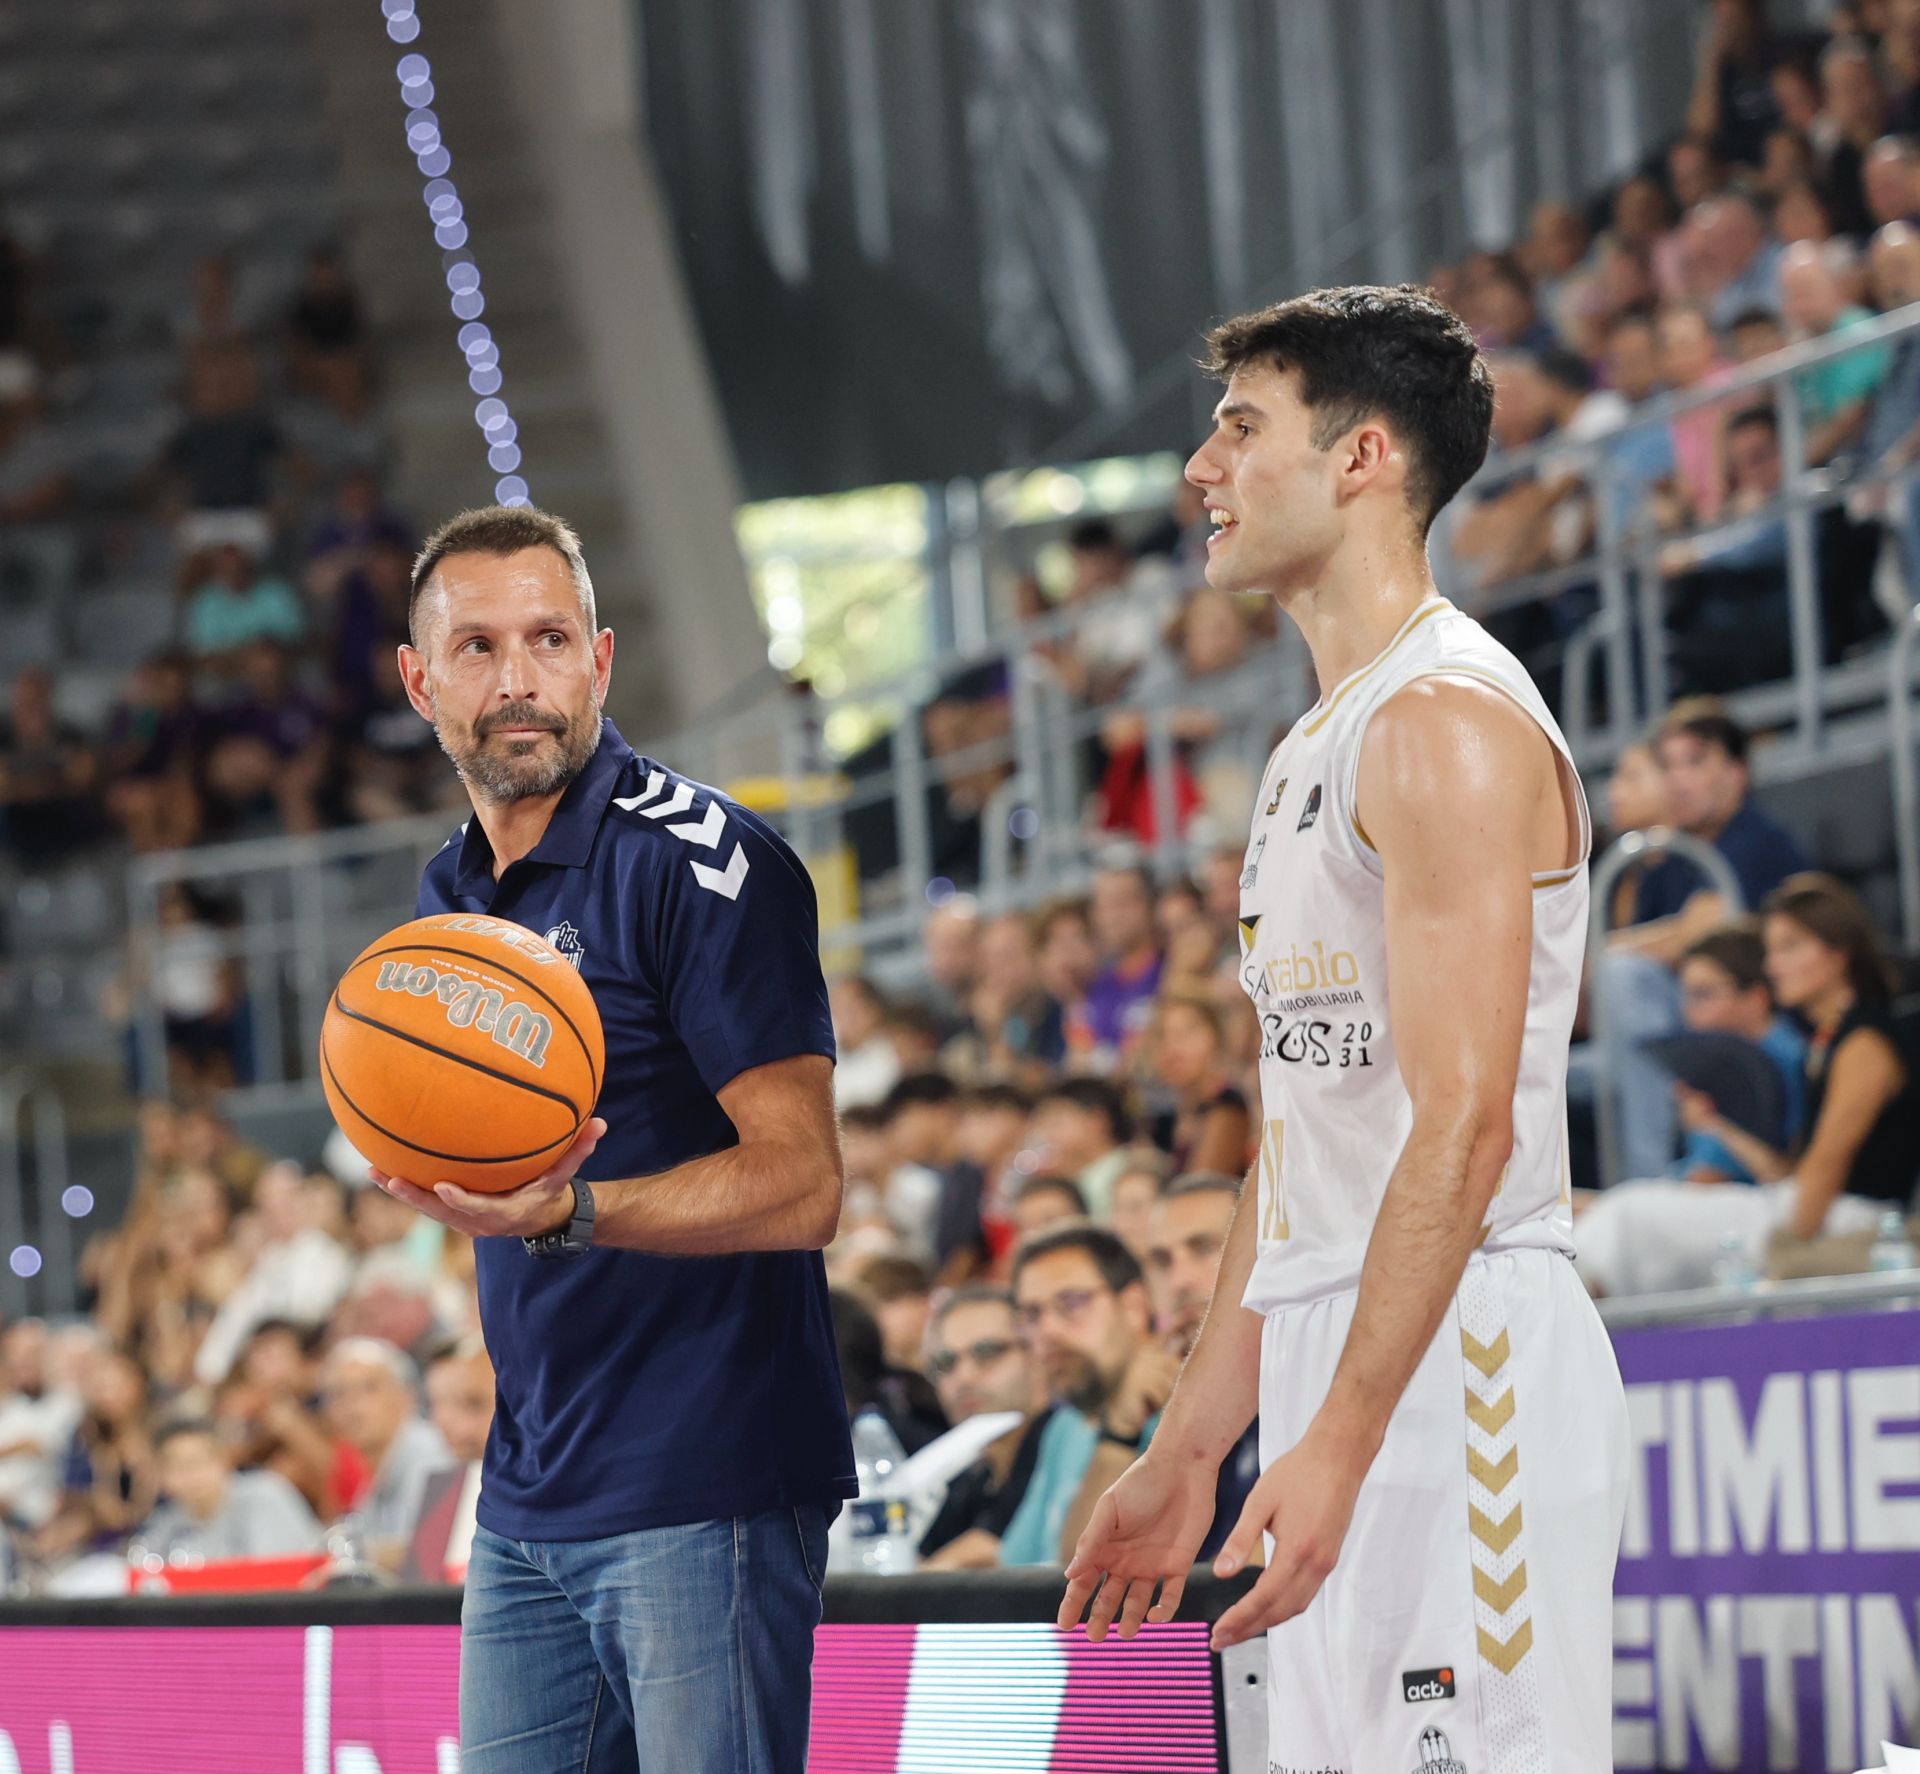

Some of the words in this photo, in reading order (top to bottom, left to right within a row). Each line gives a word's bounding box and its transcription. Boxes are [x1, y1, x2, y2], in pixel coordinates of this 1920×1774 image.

[431, 958, 451, 968] BALL
[454, 965, 479, 977] GAME
[482, 975, 515, 992] INDOOR
[377, 961, 552, 1068] Wilson
[1343, 1022, 1372, 1043] 20
[1340, 1047, 1373, 1067] 31
[1407, 1680, 1444, 1700] acb
